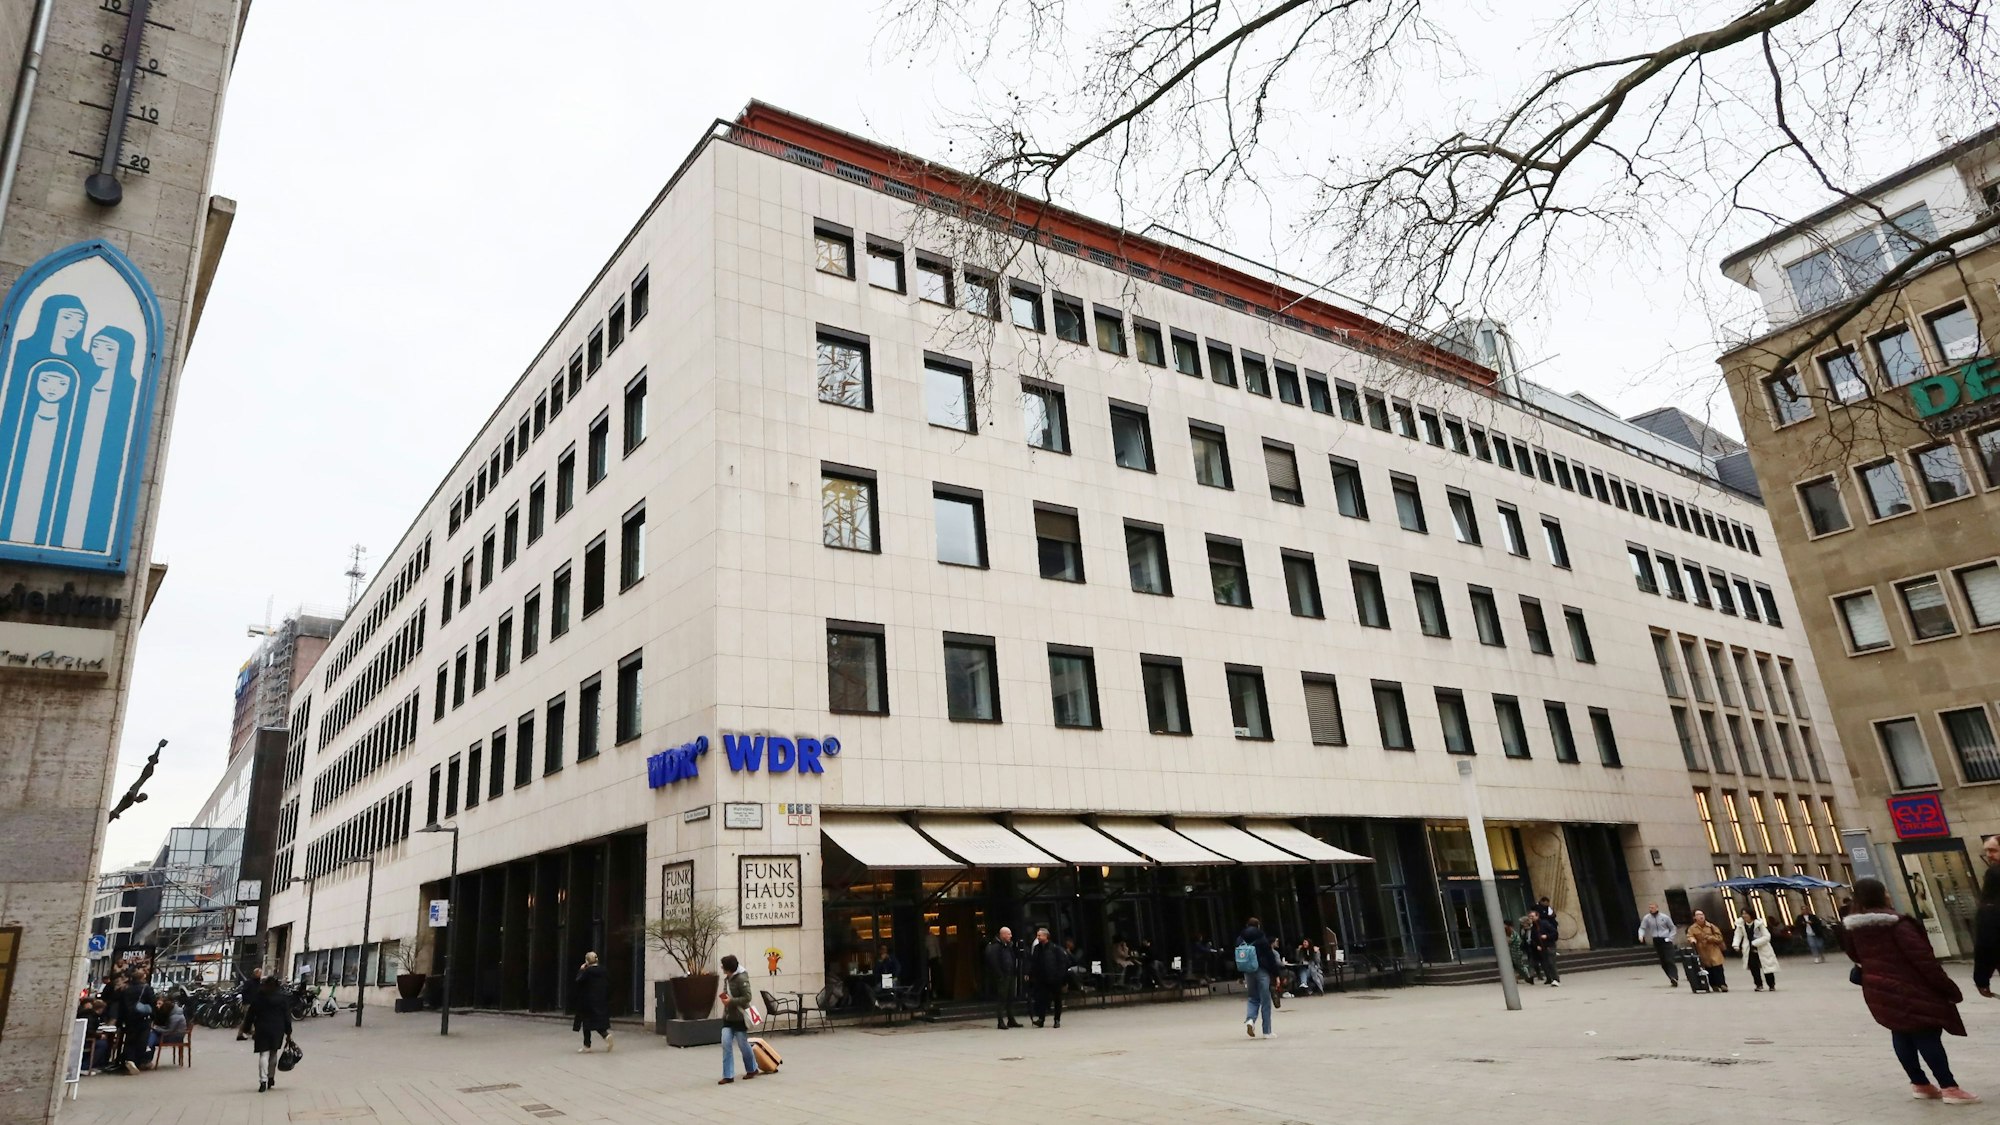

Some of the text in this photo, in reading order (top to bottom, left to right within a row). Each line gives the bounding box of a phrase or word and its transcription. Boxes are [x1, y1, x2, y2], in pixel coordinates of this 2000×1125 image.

[140, 106, 159, 120] 10
[129, 155, 150, 169] 20
[723, 734, 825, 774] WDR
[666, 868, 691, 888] FUNK
[745, 863, 794, 879] FUNK
[666, 887, 691, 906] HAUS
[745, 882, 795, 899] HAUS
[778, 901, 795, 909] BAR
[745, 911, 796, 921] RESTAURANT
